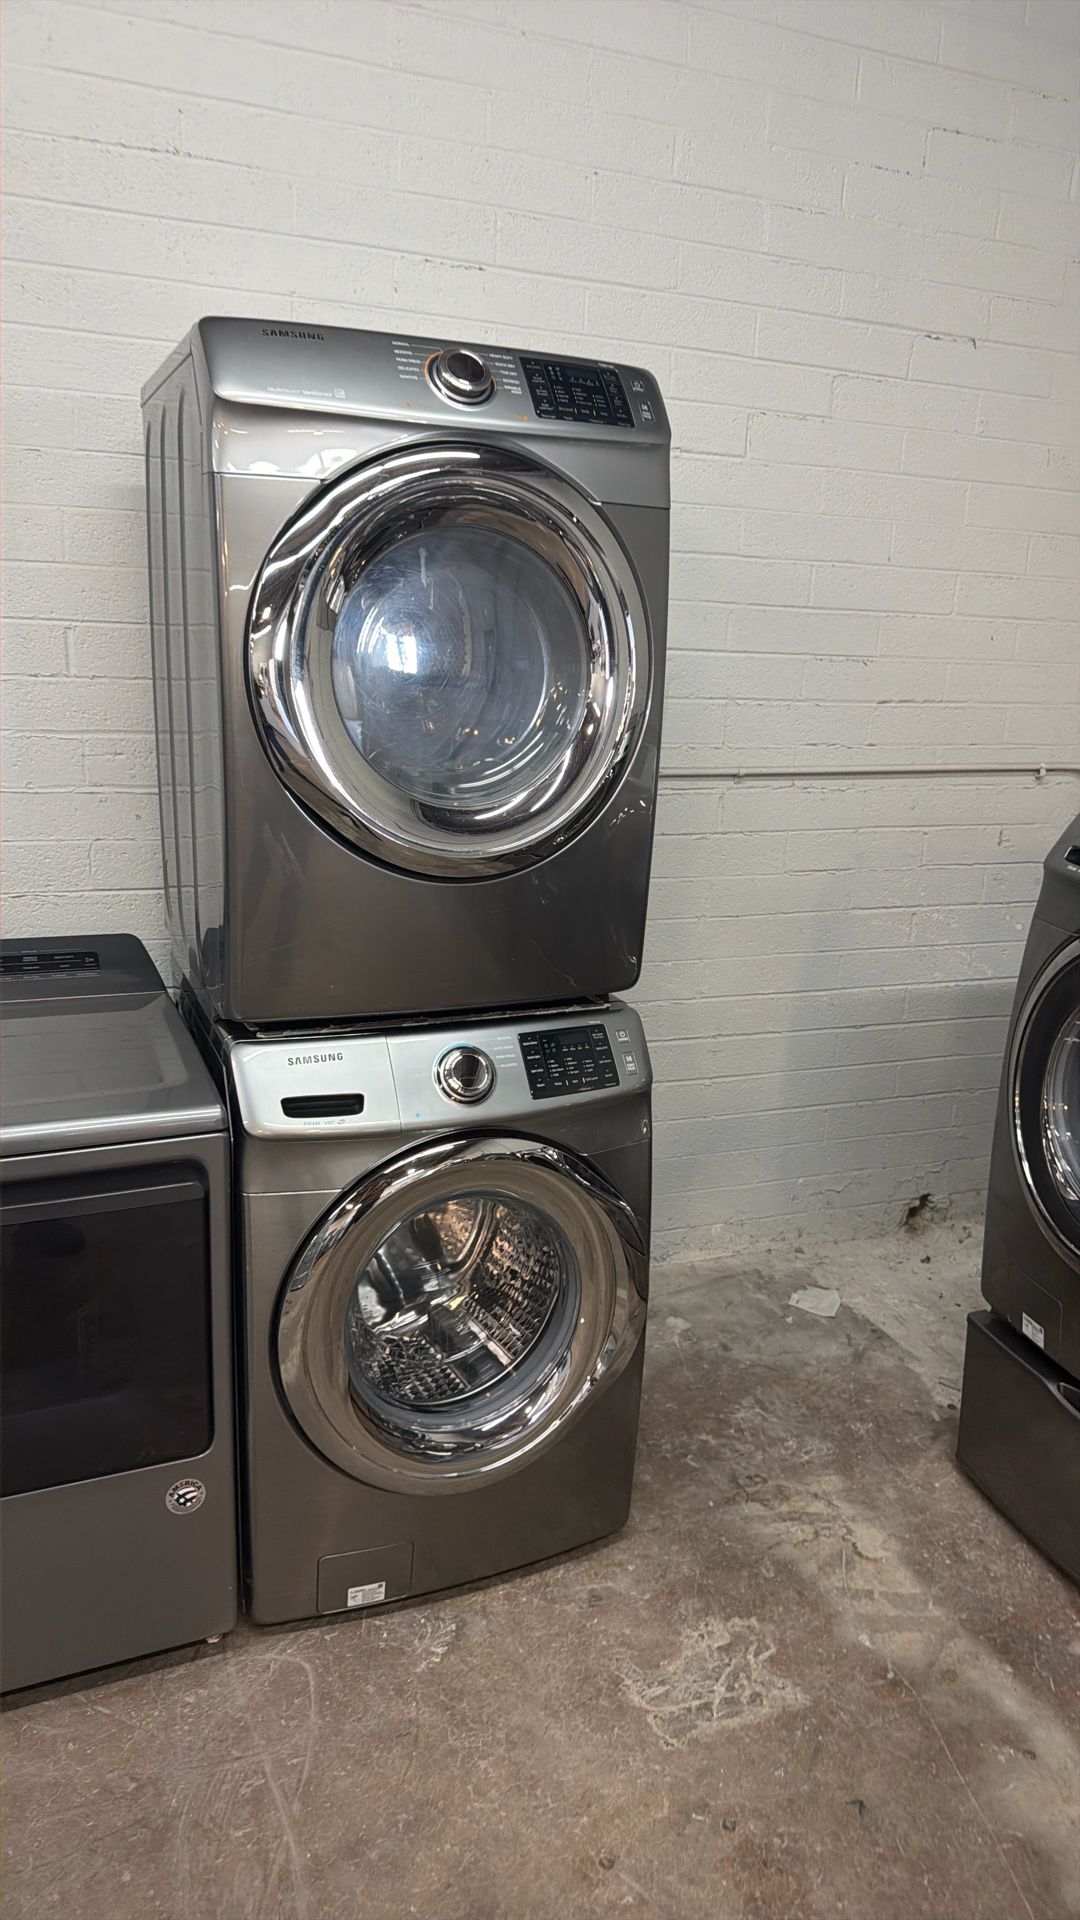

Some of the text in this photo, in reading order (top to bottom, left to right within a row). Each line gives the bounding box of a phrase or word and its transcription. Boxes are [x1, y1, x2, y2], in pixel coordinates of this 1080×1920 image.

[261, 328, 325, 341] SAMSUNG
[287, 1052, 344, 1066] SAMSUNG
[168, 1480, 202, 1498] AMERICA
